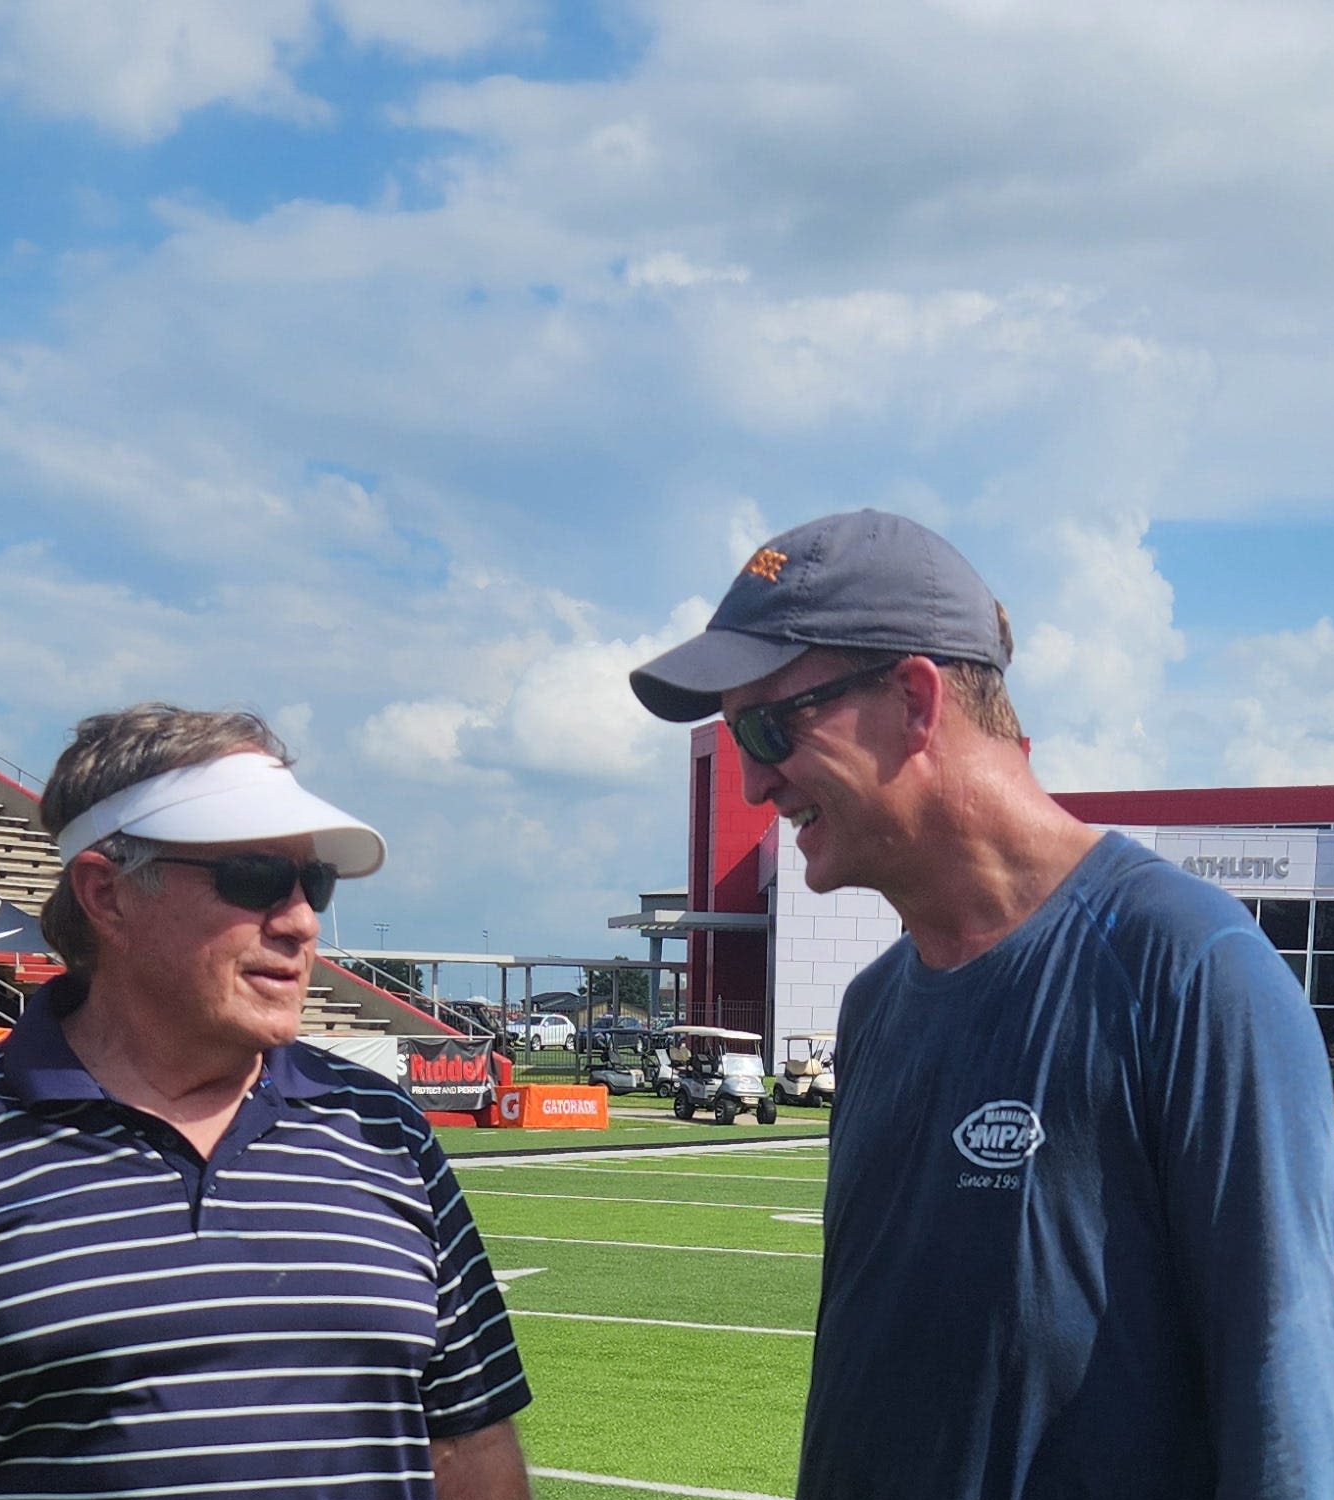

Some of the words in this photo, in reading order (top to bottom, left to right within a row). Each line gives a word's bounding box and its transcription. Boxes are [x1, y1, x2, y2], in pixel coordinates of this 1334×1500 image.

[1182, 856, 1289, 879] ATHLETIC
[411, 1053, 489, 1082] Riddell
[411, 1086, 441, 1095] PROTECT
[441, 1086, 457, 1094] AND
[501, 1092, 519, 1121] G
[543, 1099, 598, 1115] GATORADE
[968, 1123, 1031, 1150] MPA
[956, 1173, 991, 1188] Since
[993, 1174, 1020, 1190] 199
